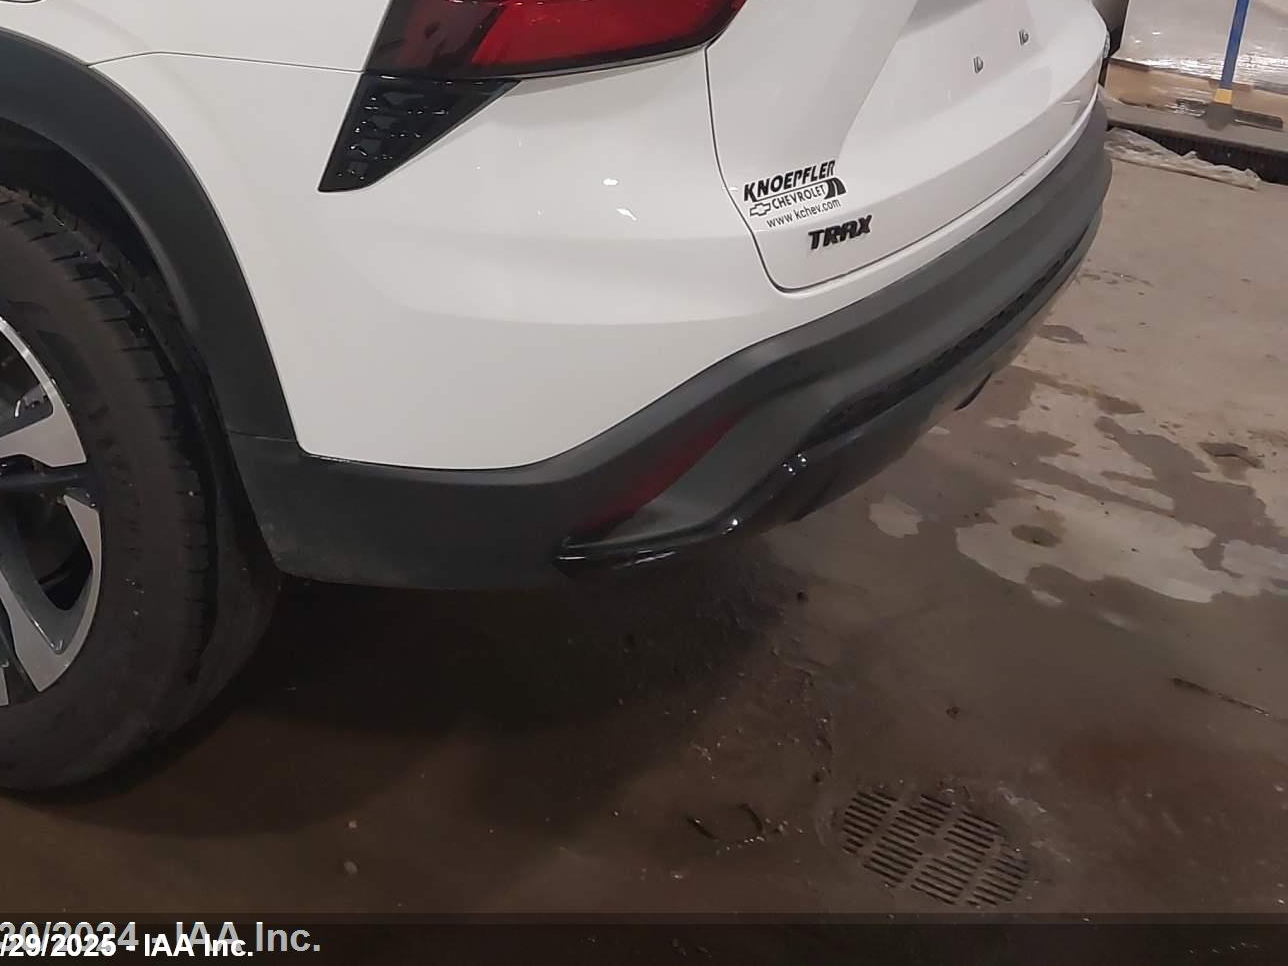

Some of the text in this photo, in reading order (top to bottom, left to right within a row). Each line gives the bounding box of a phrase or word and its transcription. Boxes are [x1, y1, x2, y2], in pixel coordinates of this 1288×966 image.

[744, 159, 836, 202] KNOEPFLER
[772, 184, 826, 209] CHEVROLET
[766, 198, 842, 228] wwwkchev.com
[808, 214, 872, 250] TRAX
